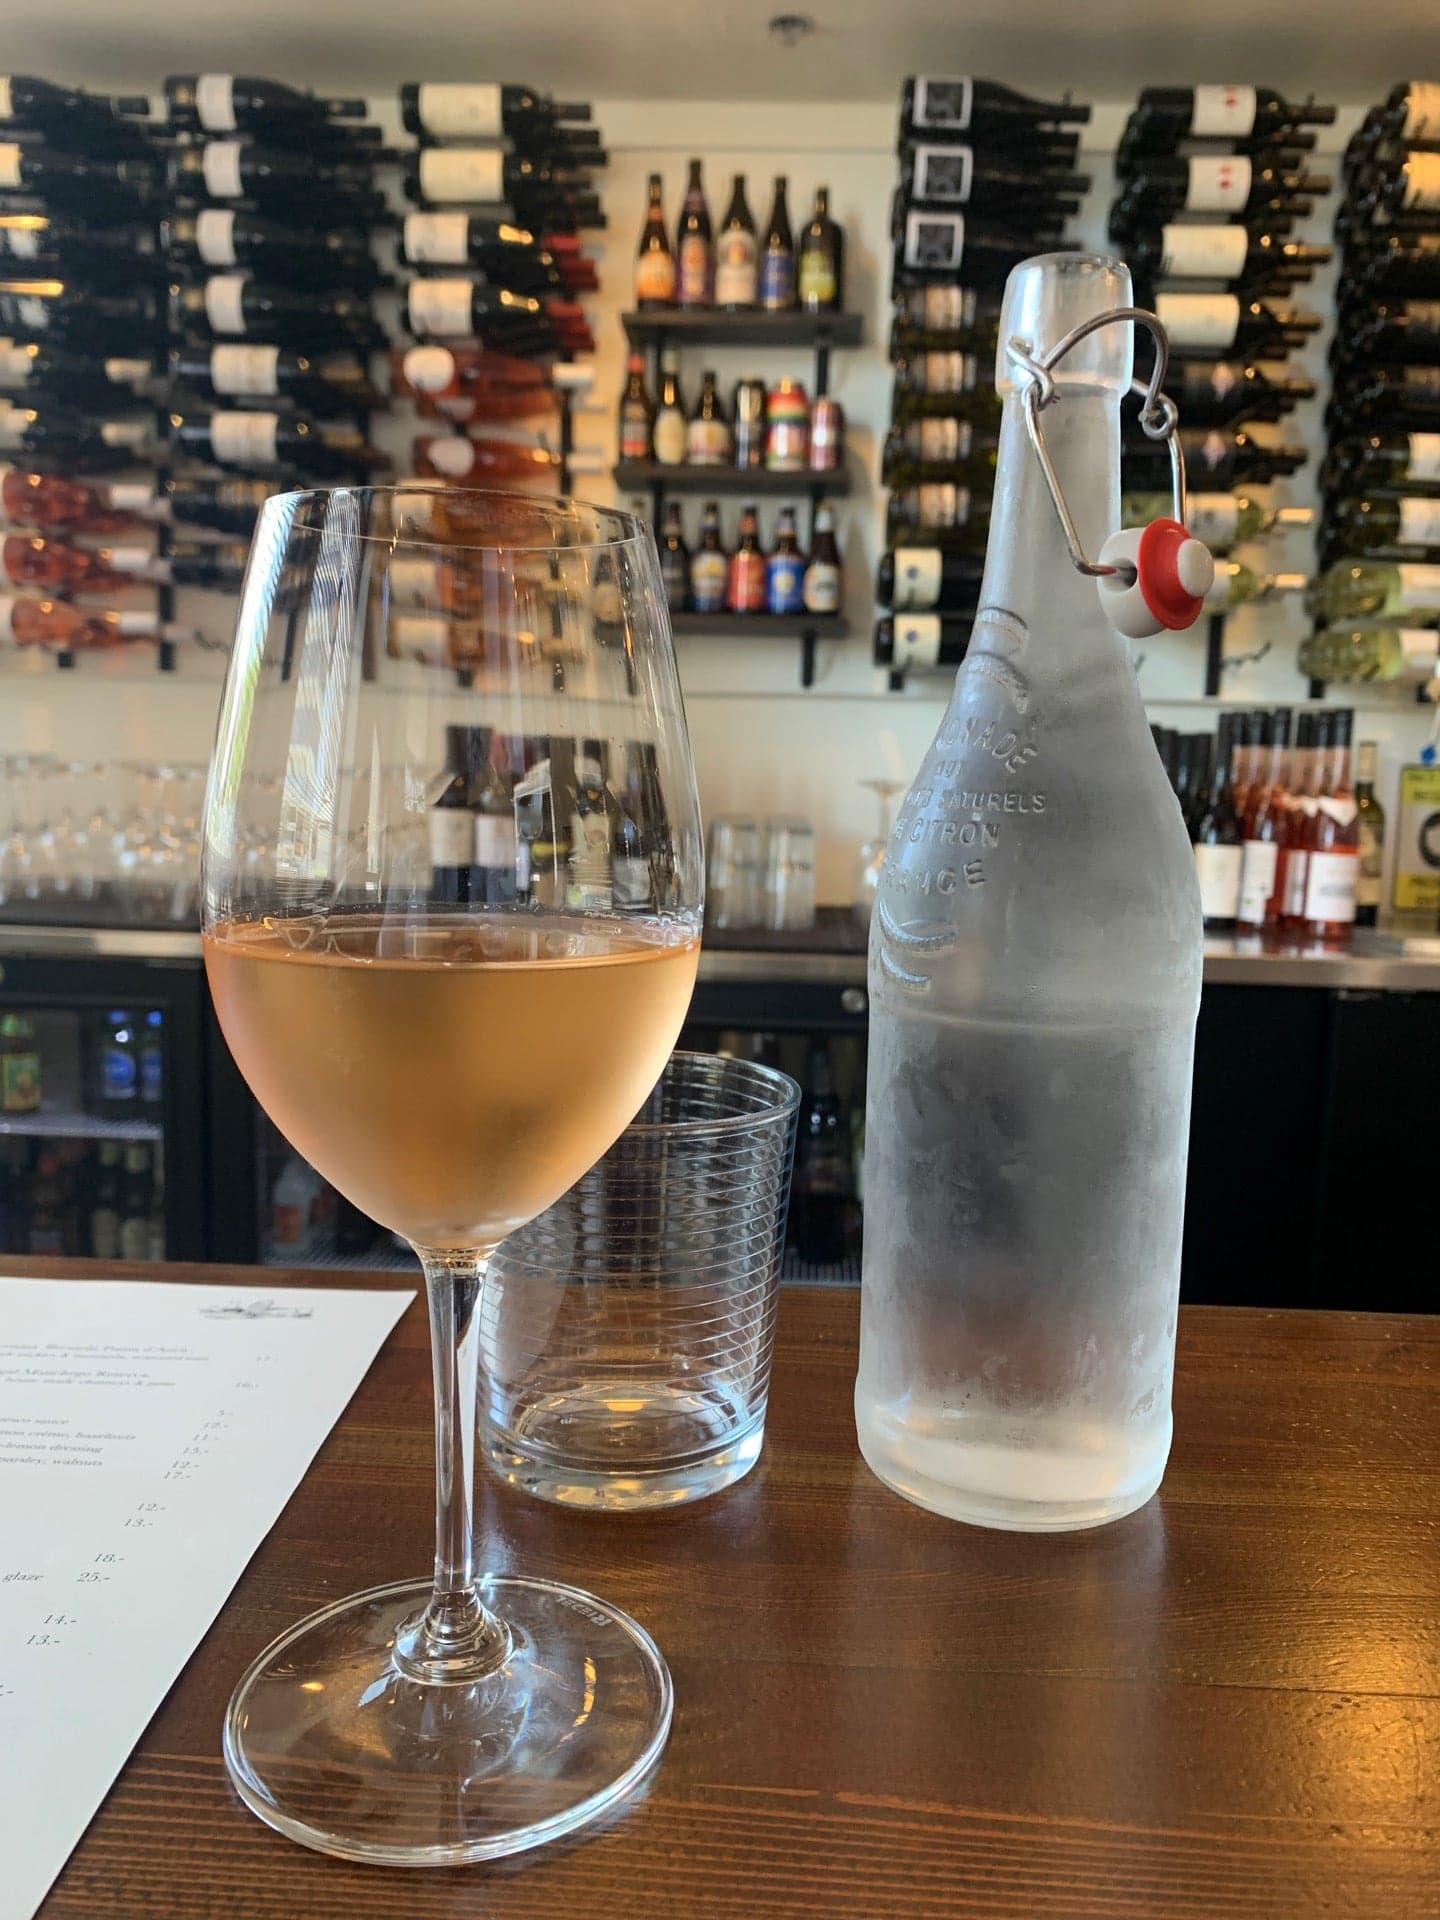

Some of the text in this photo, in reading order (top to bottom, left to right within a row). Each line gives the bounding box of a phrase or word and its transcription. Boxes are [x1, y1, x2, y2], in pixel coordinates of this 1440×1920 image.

[909, 817, 1000, 848] CITRON
[137, 1502, 167, 1513] 12.-
[124, 1518, 154, 1528] 13.-
[94, 1552, 126, 1564] 18.-
[1, 1571, 112, 1584] glaze 25.-
[43, 1614, 78, 1625] 14.-
[26, 1634, 62, 1646] 13.-
